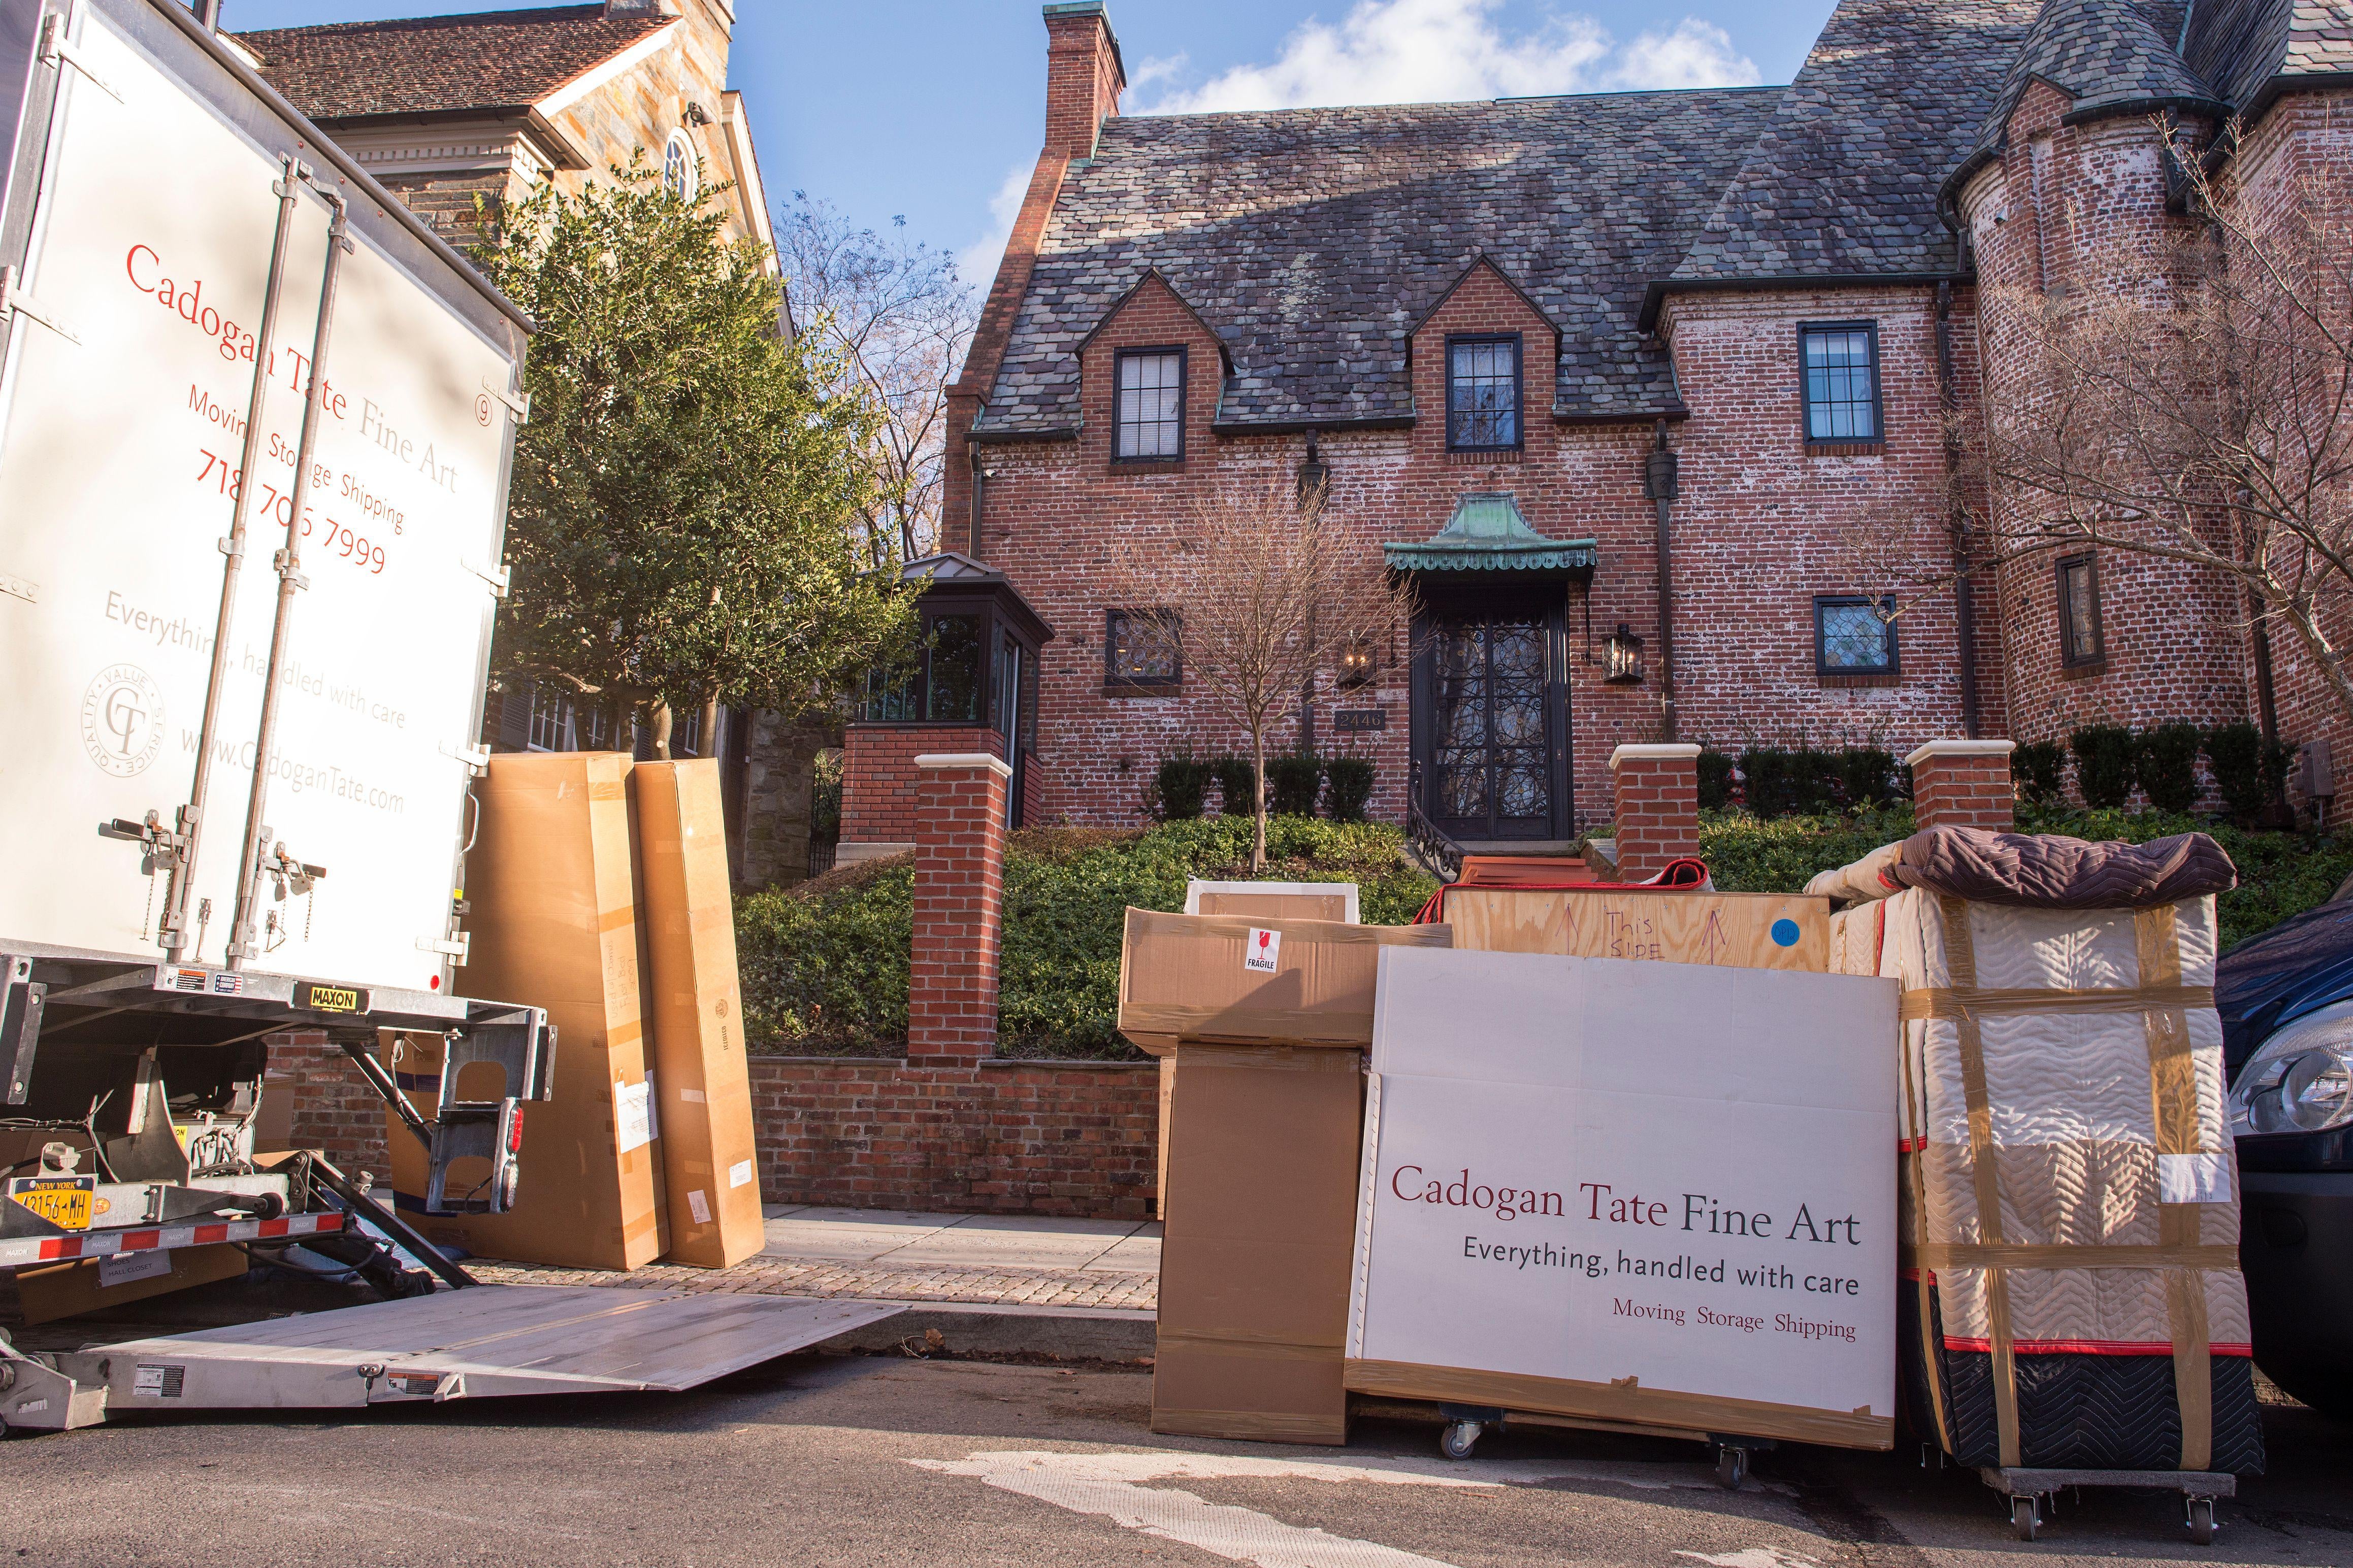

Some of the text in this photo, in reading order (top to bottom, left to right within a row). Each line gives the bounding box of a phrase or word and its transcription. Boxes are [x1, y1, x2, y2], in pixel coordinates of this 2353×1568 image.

[189, 384, 247, 440] Movin
[341, 474, 404, 535] Shipping
[359, 397, 412, 463] Fine
[418, 443, 458, 493] Art
[197, 448, 244, 503] 718
[324, 518, 385, 574] 7999
[106, 590, 233, 670] Everythin,
[331, 685, 366, 715] with
[372, 704, 405, 728] care
[105, 669, 148, 689] VALUE
[84, 689, 108, 766] QUALITY
[1340, 714, 1381, 726] 2446
[126, 707, 163, 773] SERVICE
[1606, 911, 1652, 936] This
[1248, 958, 1274, 969] FRAGILE
[1611, 939, 1665, 959] SIDE
[312, 989, 353, 1007] MAXON
[35, 1182, 55, 1190] NEW
[1392, 1165, 1861, 1246] Cadogan Tate Fine Art
[107, 1258, 130, 1267] SHOES
[127, 1263, 153, 1273] CLOSET
[1464, 1236, 1859, 1295] Everything, handled with care
[1613, 1297, 1856, 1343] Moving Storage Shipping
